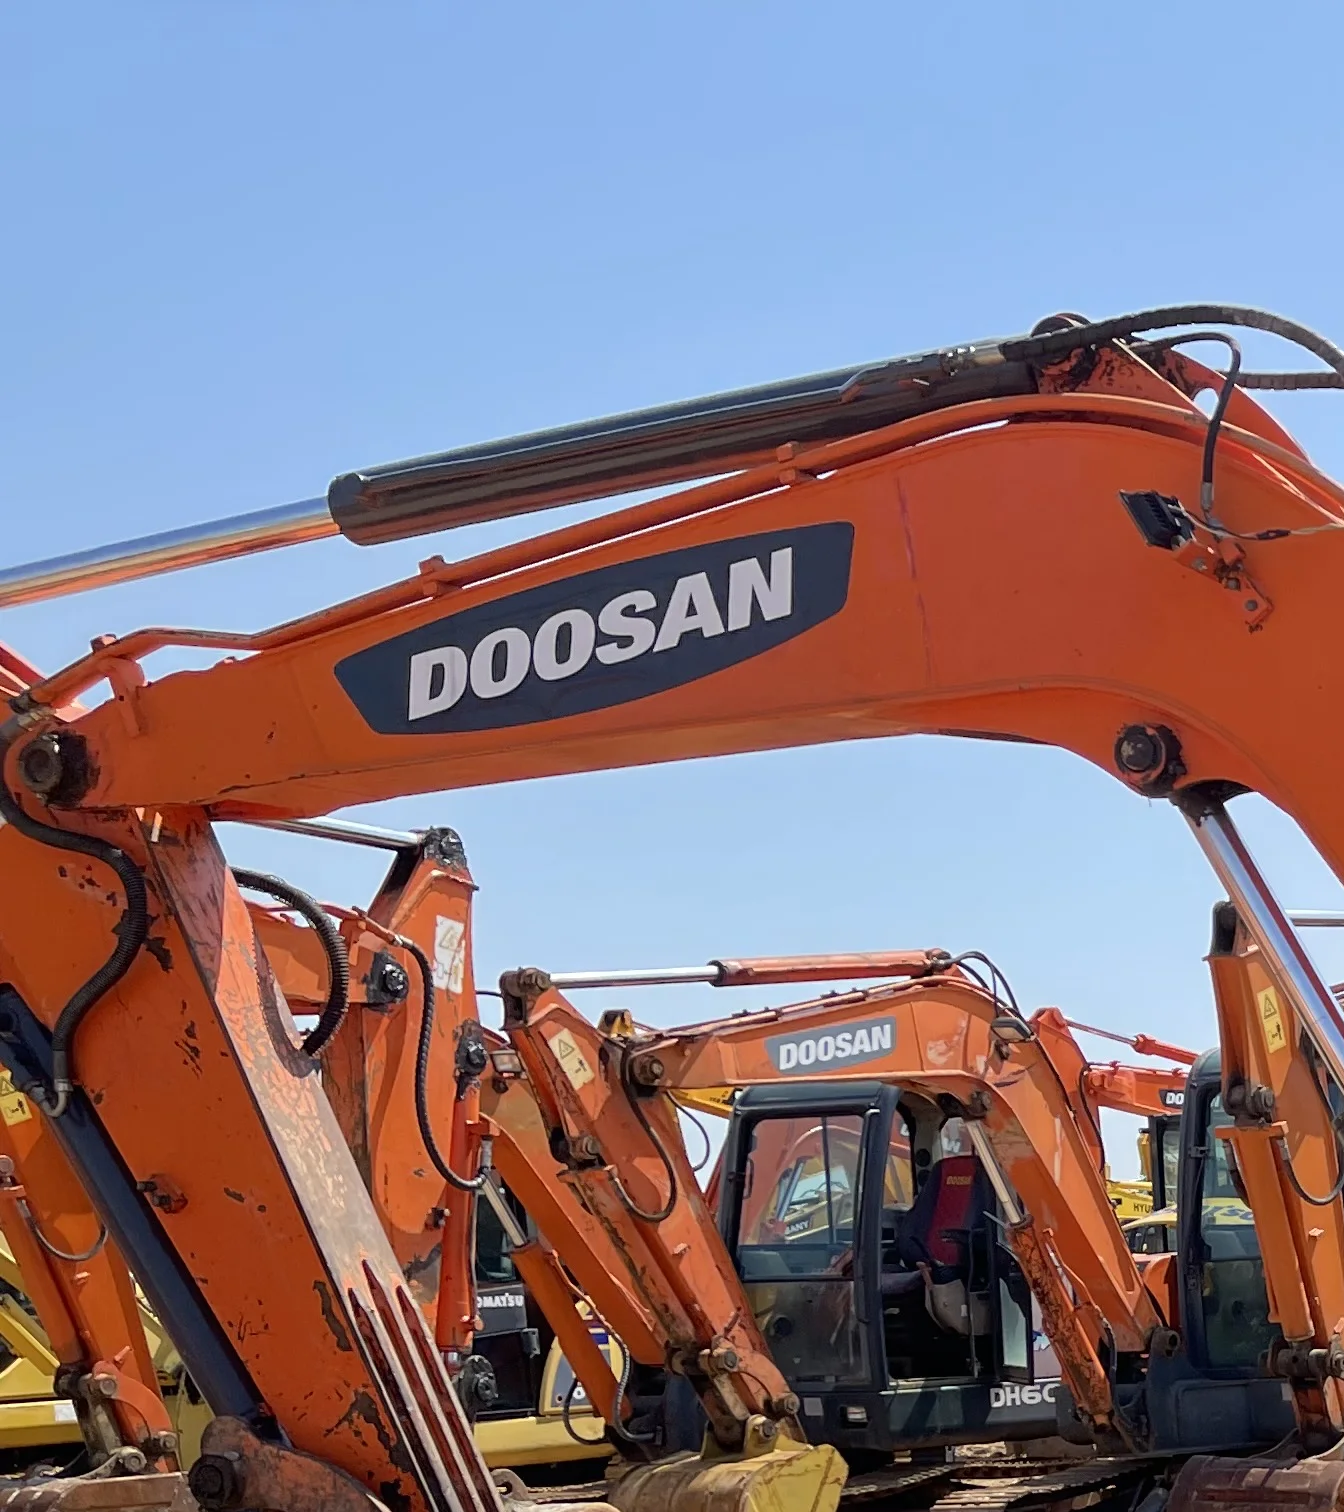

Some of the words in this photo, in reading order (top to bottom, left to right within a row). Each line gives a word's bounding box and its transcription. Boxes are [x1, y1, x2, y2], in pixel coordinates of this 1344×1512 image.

[409, 547, 793, 721] DOOSAN
[779, 1024, 892, 1071] DOOSAN
[477, 1293, 524, 1308] OMATSU
